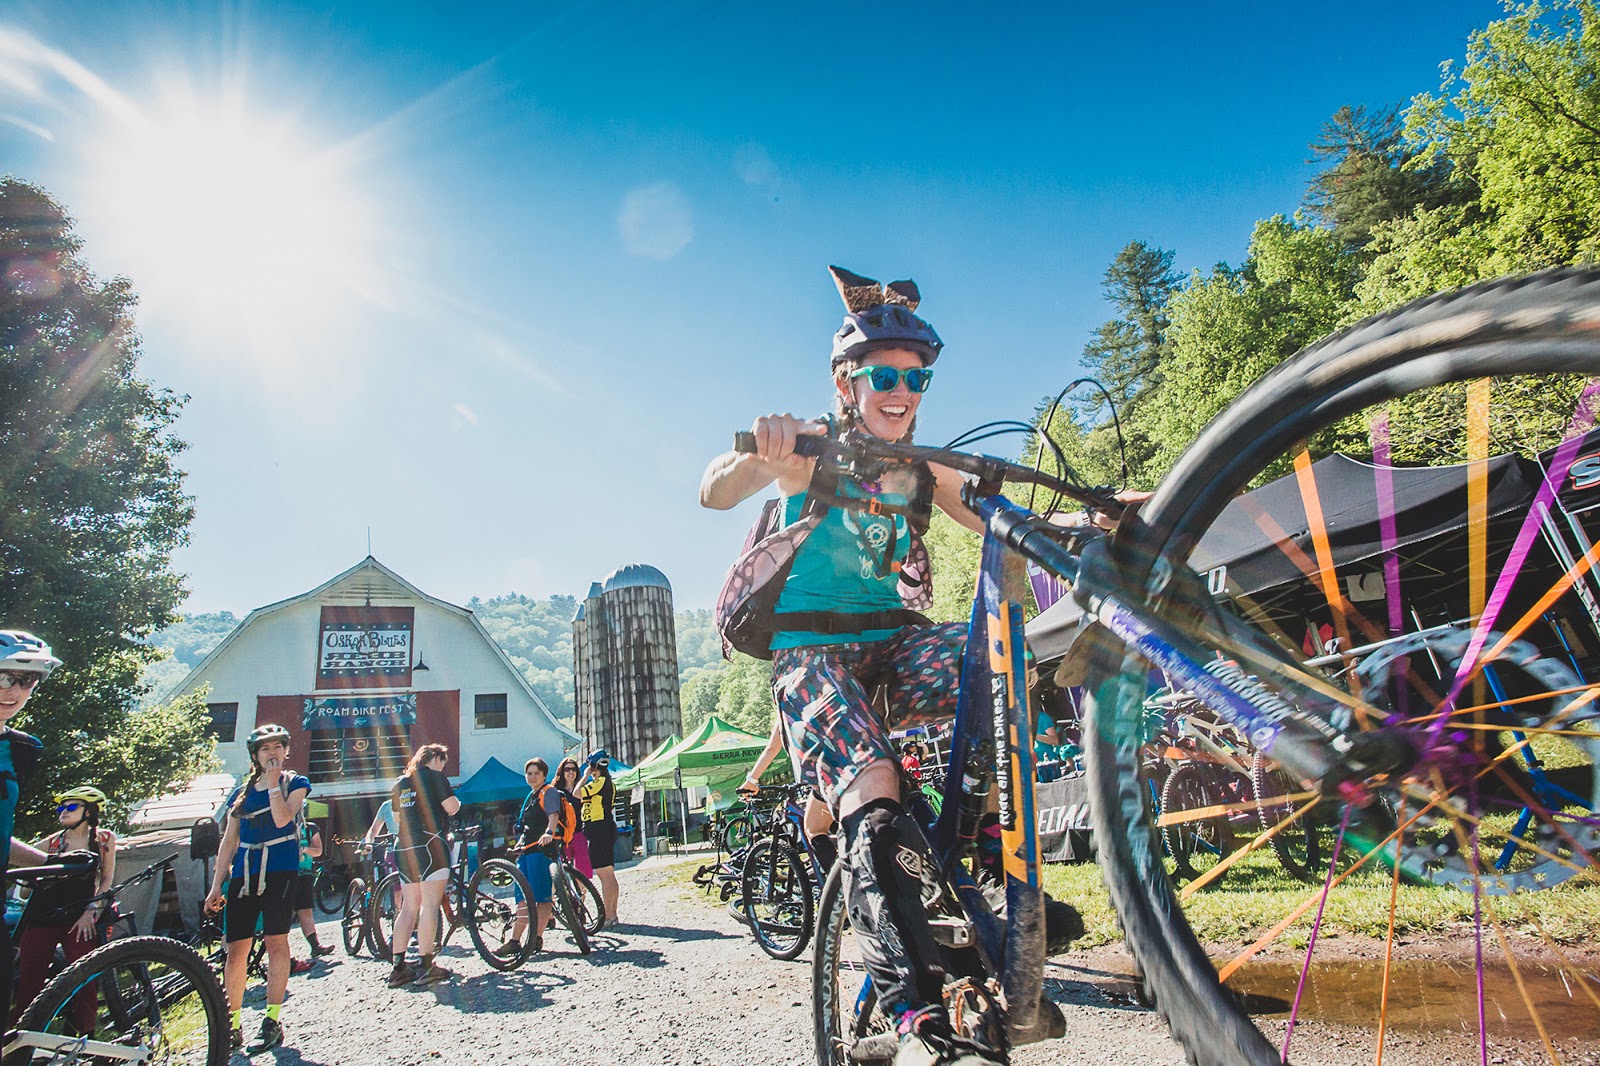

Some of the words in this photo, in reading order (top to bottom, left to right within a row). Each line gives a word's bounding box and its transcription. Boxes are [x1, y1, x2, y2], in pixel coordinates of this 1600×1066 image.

[326, 632, 367, 649] OSKAR
[367, 631, 406, 648] BLUES
[318, 706, 350, 717] ROAM
[352, 705, 377, 716] BIKE
[379, 703, 404, 715] FEST
[712, 751, 740, 760] SIERRA
[741, 748, 766, 757] NEVA
[1036, 803, 1095, 835] ECIAL
